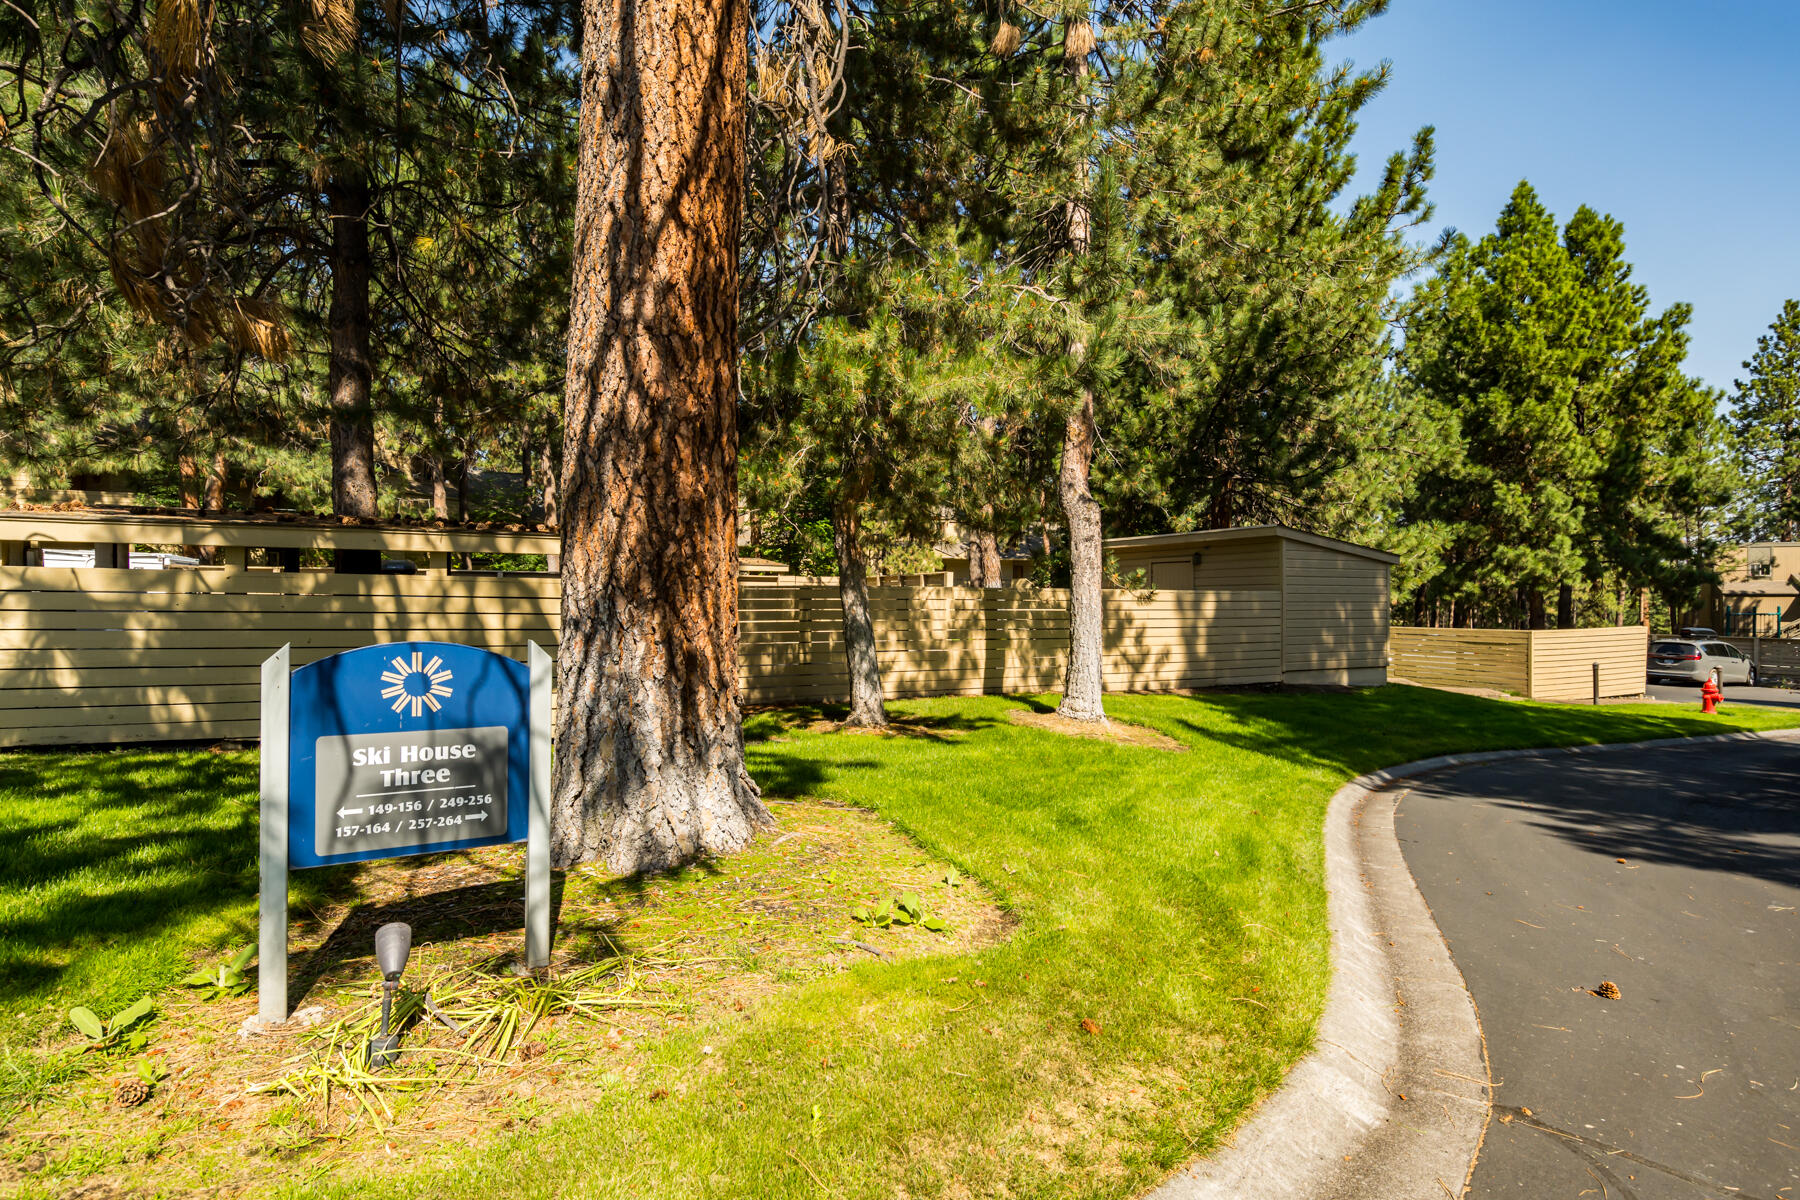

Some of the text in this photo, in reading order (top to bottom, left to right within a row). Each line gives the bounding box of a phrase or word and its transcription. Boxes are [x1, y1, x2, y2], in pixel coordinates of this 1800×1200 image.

[352, 743, 477, 767] Ski House
[380, 768, 451, 787] Three
[368, 794, 492, 815] 149-156 / 249-256
[335, 815, 463, 838] 157-164 / 257-264
